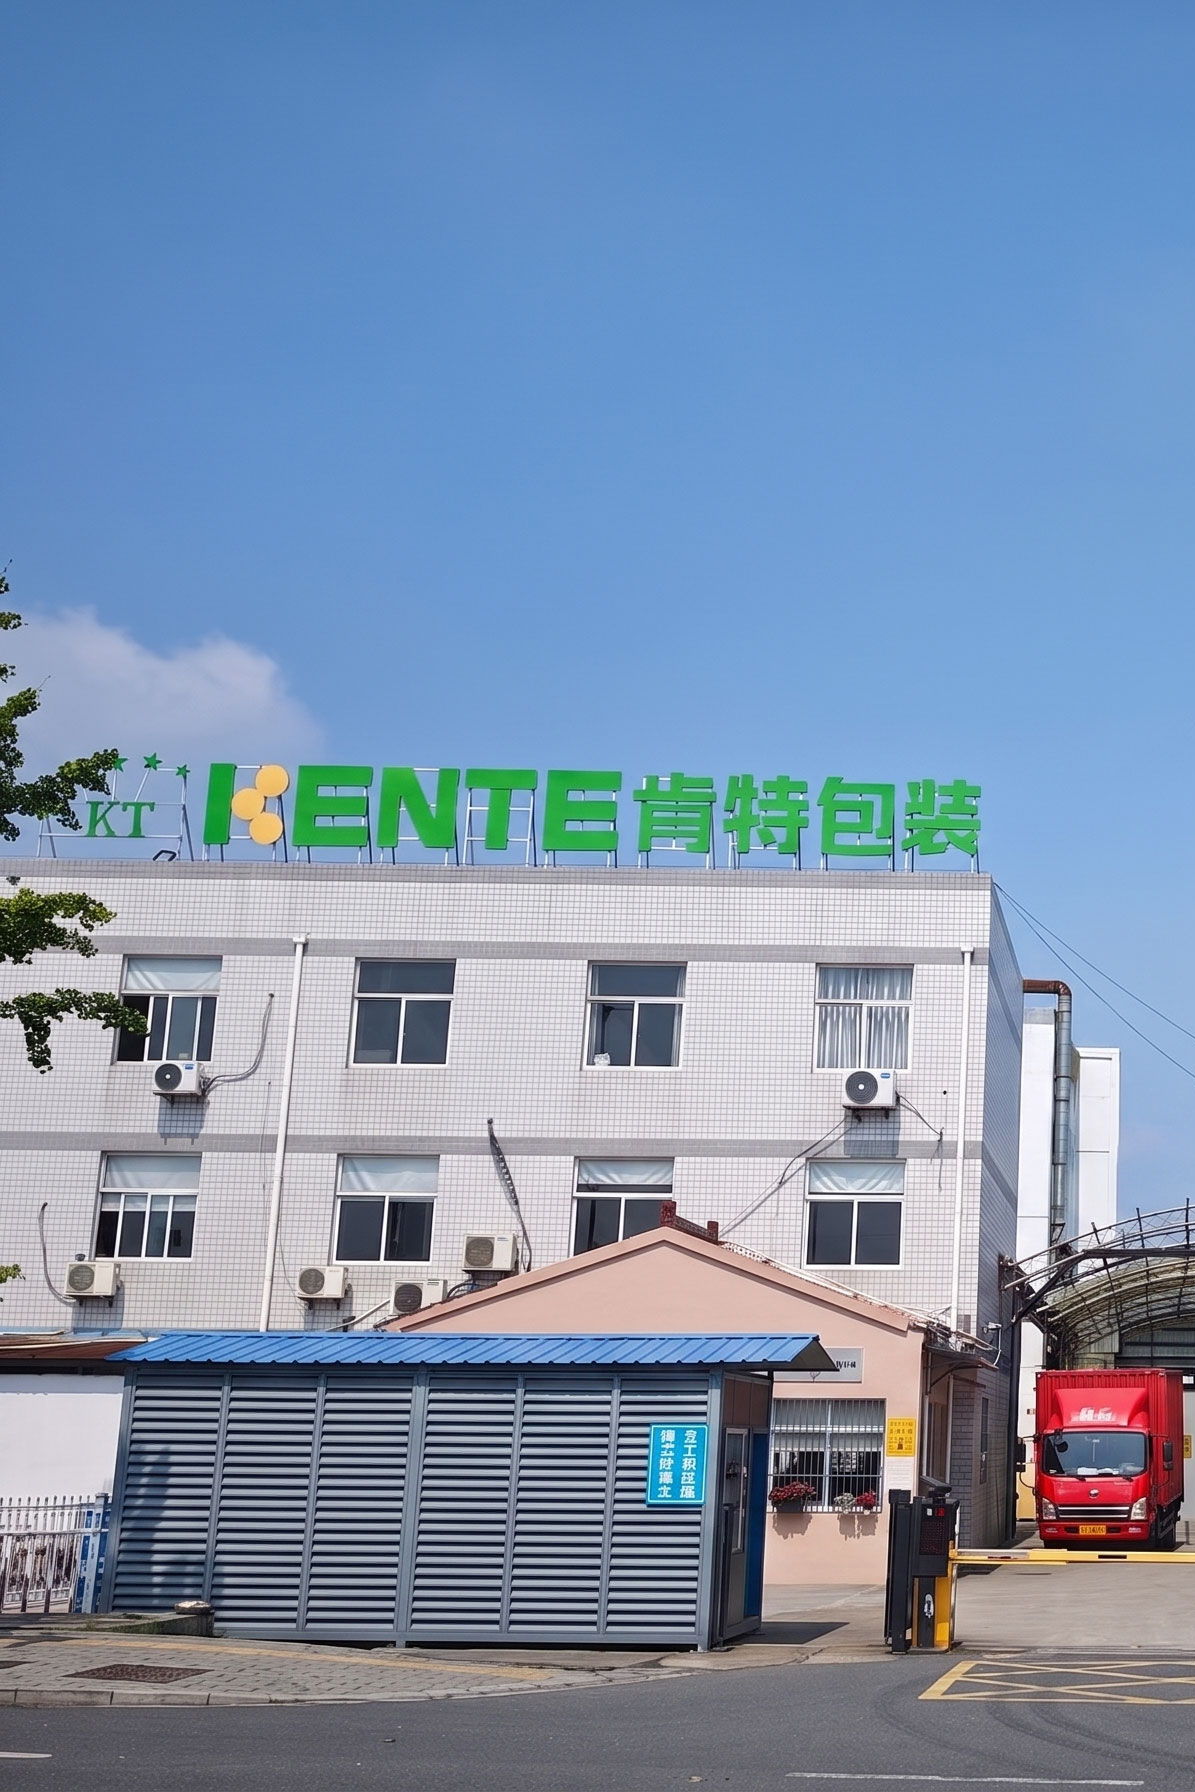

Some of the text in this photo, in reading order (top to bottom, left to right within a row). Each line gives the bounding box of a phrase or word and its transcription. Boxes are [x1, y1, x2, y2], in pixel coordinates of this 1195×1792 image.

[86, 801, 155, 838] KT
[203, 763, 622, 852] KENTE
[633, 773, 982, 857] 肯特包装
